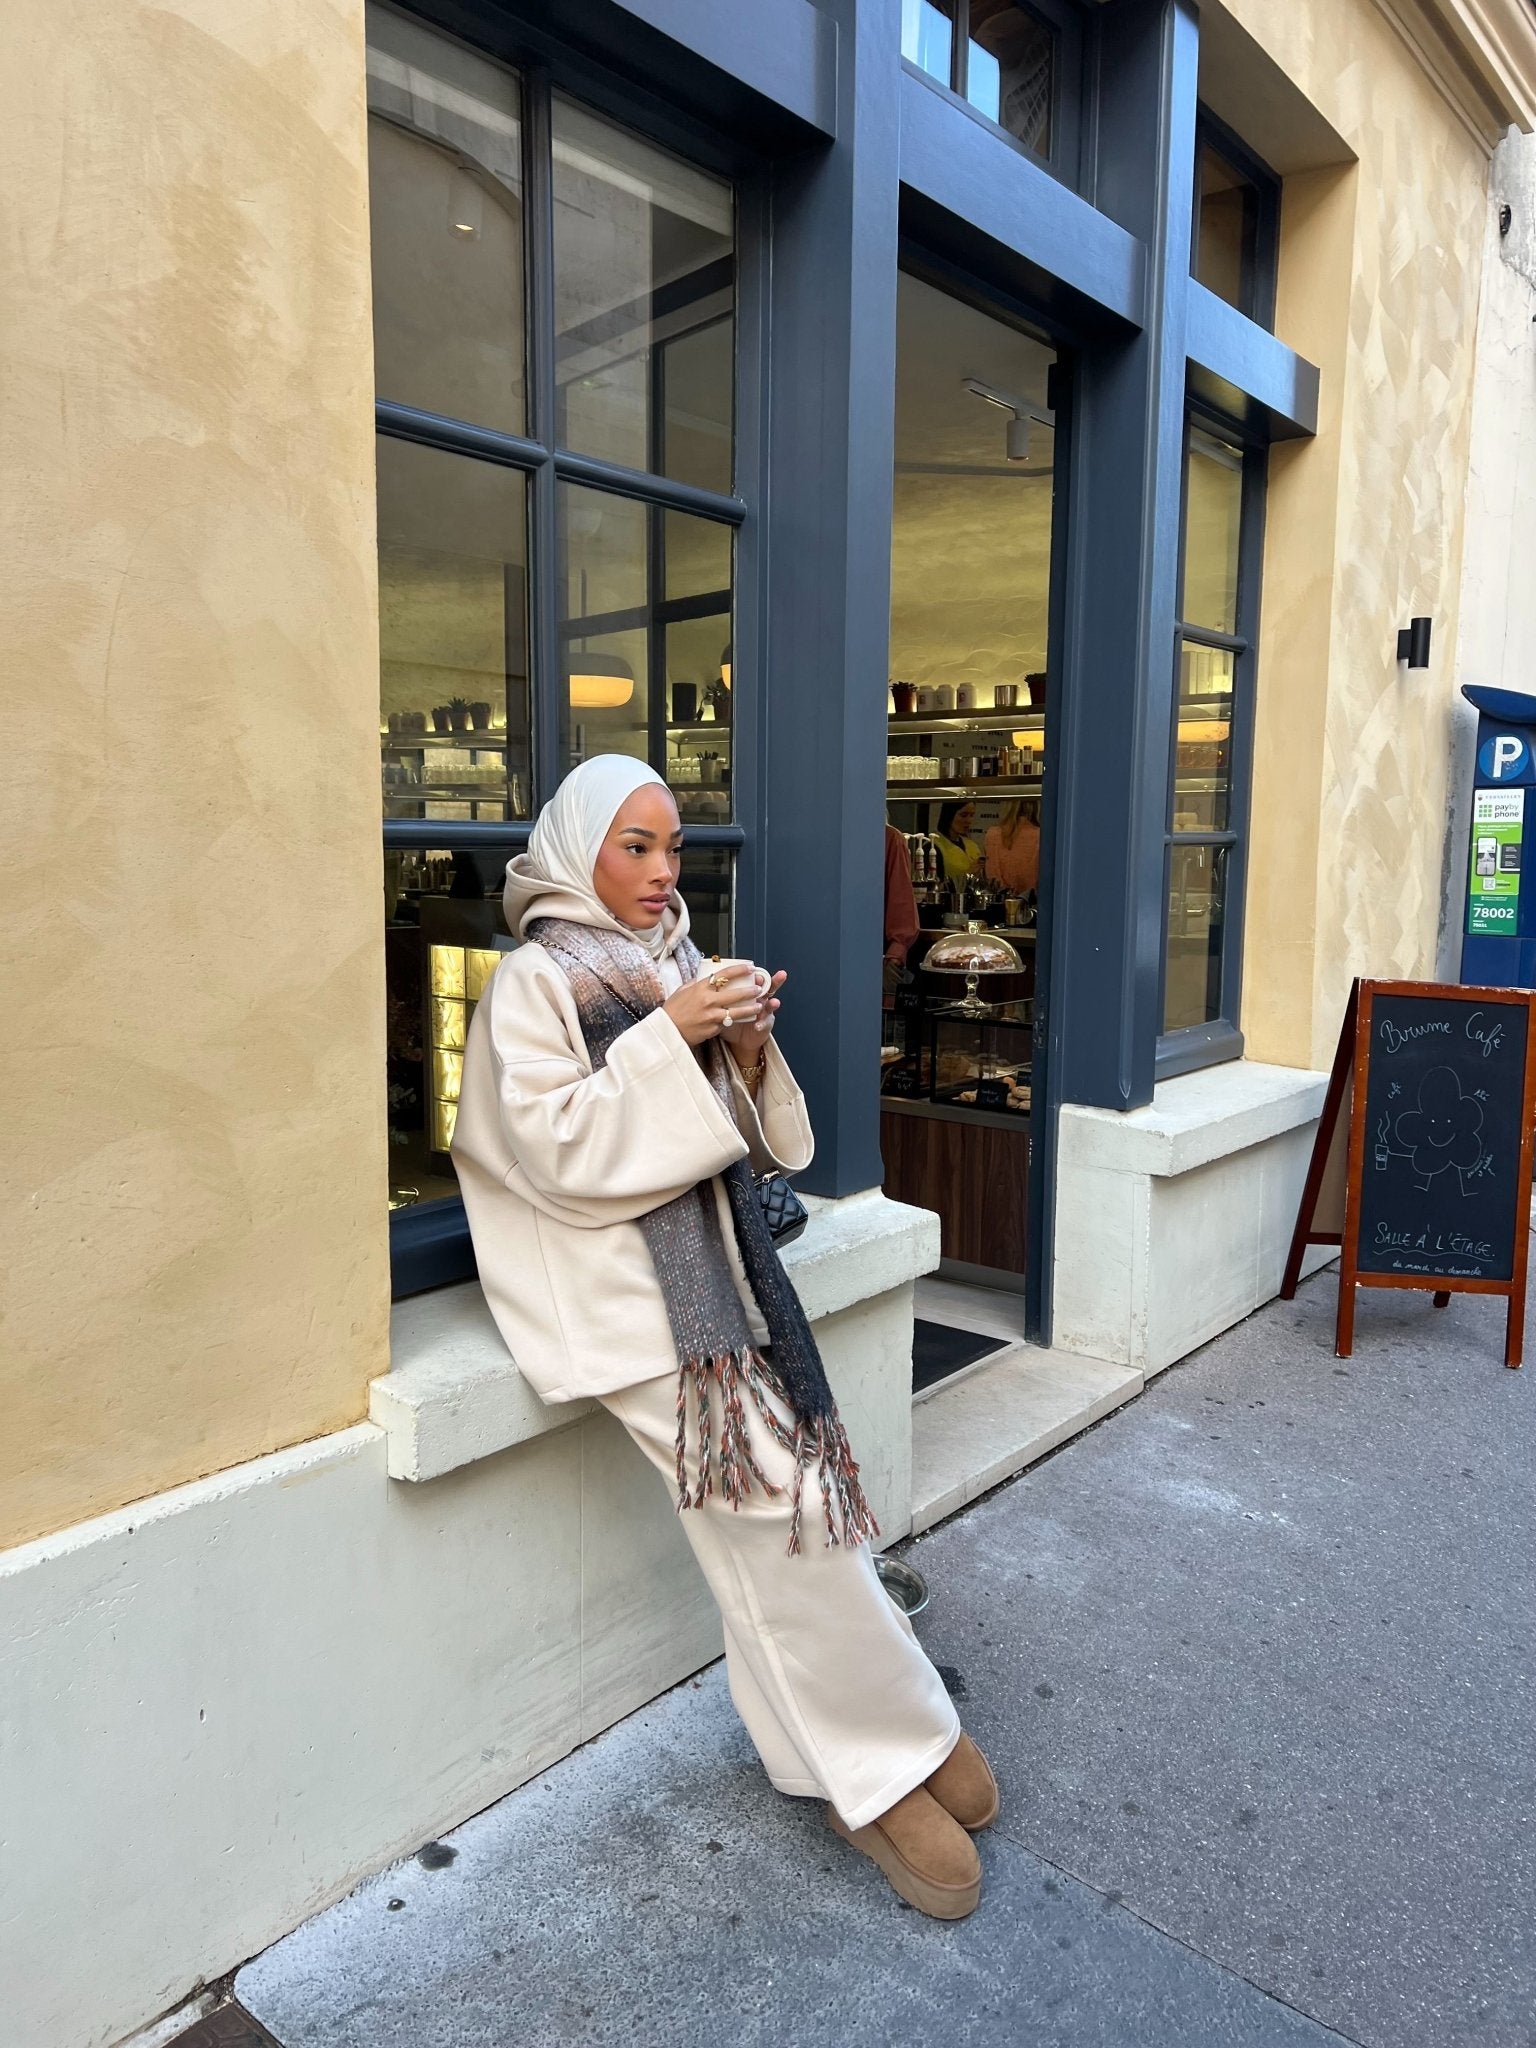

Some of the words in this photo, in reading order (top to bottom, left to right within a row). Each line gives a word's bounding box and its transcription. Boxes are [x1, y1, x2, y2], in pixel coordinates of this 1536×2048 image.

[1493, 736, 1523, 778] P
[1473, 907, 1515, 919] 78002
[1380, 1019, 1453, 1054] Brume
[1465, 1011, 1506, 1058] Café
[1374, 1221, 1411, 1247] SALLE
[1392, 1259, 1402, 1268] du
[1434, 1266, 1444, 1274] au
